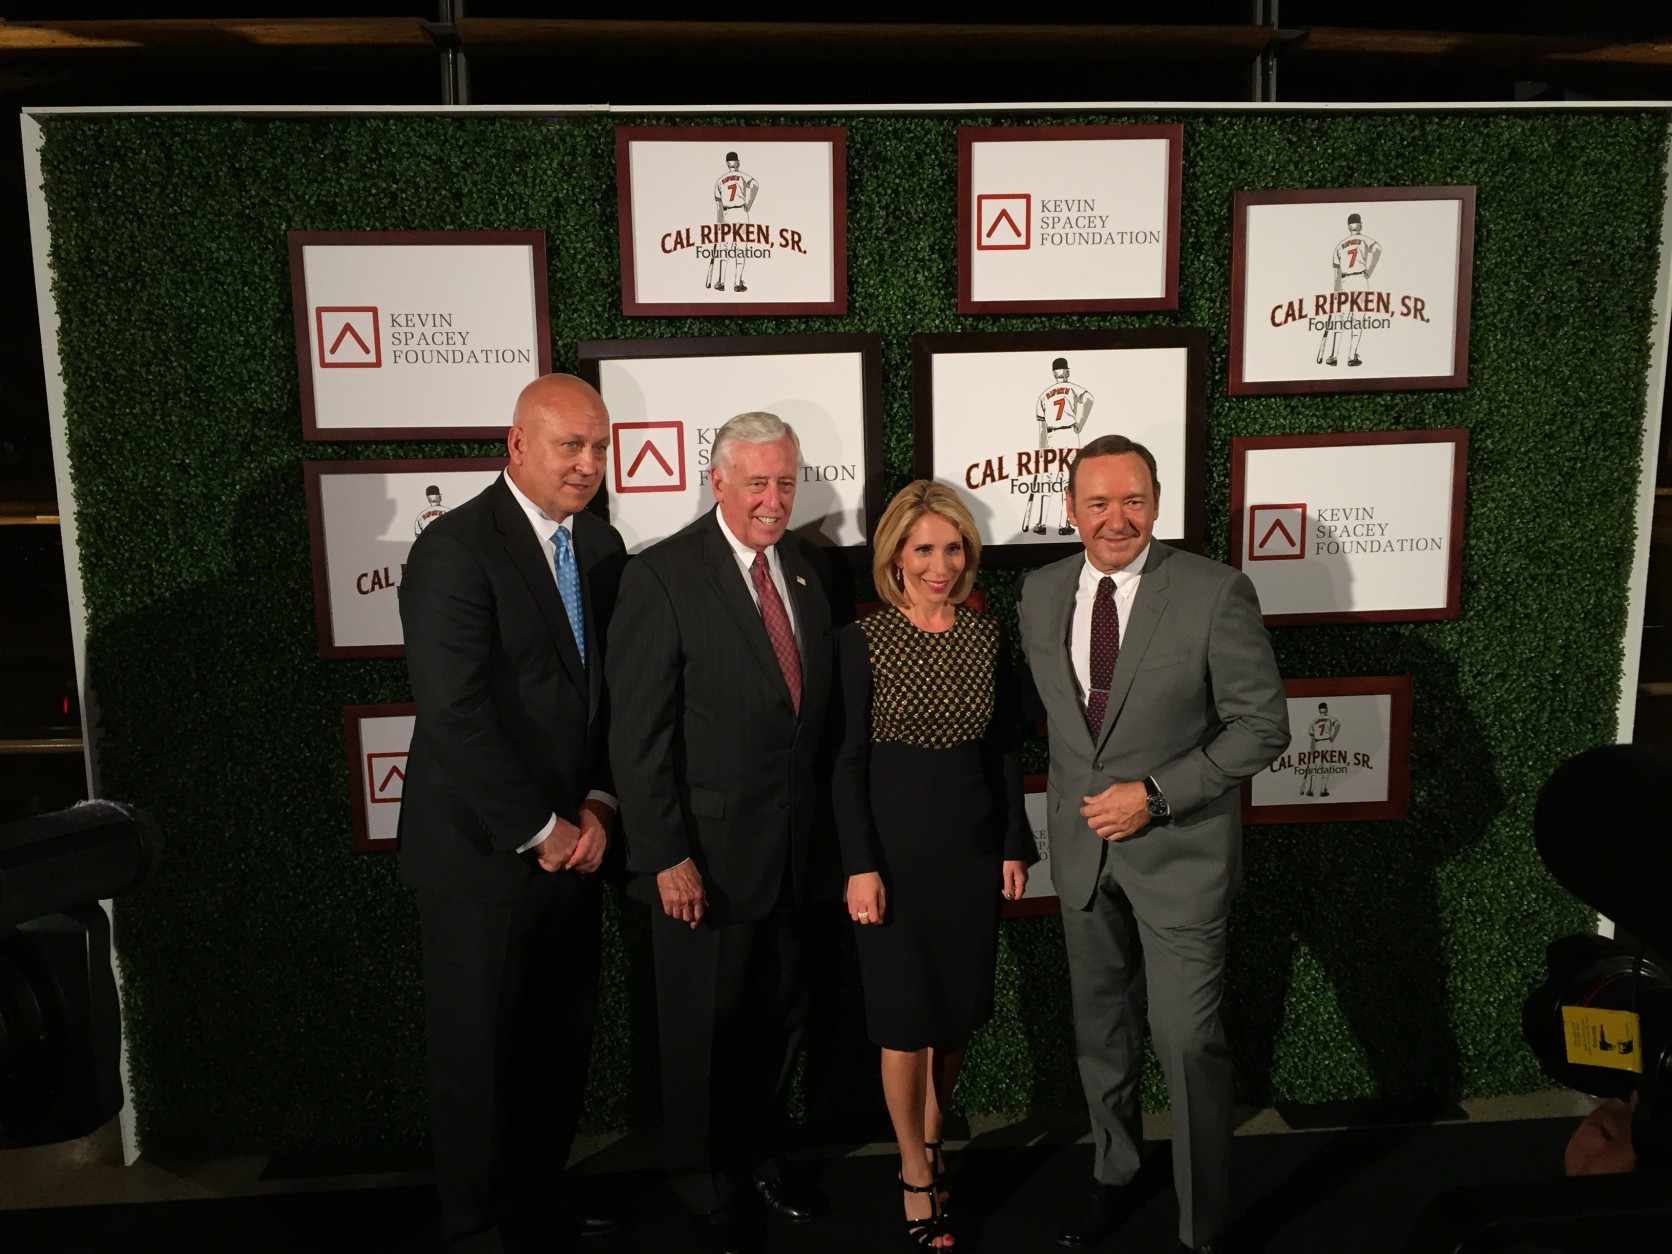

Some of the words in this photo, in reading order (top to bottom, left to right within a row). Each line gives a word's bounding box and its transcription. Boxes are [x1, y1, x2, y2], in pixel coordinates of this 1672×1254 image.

[727, 183, 737, 202] 7
[1040, 199, 1096, 213] KEVIN
[1040, 215, 1110, 230] SPACEY
[660, 227, 696, 254] CAL
[700, 222, 775, 248] RIPKEN,
[778, 228, 808, 254] SR.
[1040, 230, 1161, 246] FOUNDATION
[695, 245, 772, 259] Foundation
[1347, 248, 1358, 268] 7
[1270, 297, 1309, 328] CAL
[1314, 291, 1396, 318] RIPKEN,
[1400, 294, 1431, 324] SR.
[389, 313, 453, 328] KEVIN
[1308, 316, 1391, 332] Foundation
[391, 331, 470, 346] SPACEY
[392, 349, 531, 364] FOUNDATION
[1045, 387, 1070, 400] RIPKEN
[1053, 397, 1066, 421] 7
[965, 454, 1010, 490] CAL
[1016, 447, 1083, 478] RIPK
[1316, 506, 1375, 522] KEVIN
[1315, 522, 1390, 539] SPACEY
[1315, 537, 1443, 555] FOUNDATION
[355, 566, 396, 596] CAL
[1318, 723, 1326, 737] 7
[1269, 754, 1295, 773] CAL
[1297, 749, 1351, 767] RIPKEN,
[1353, 752, 1374, 770] SR.
[1294, 765, 1348, 776] Foundation
